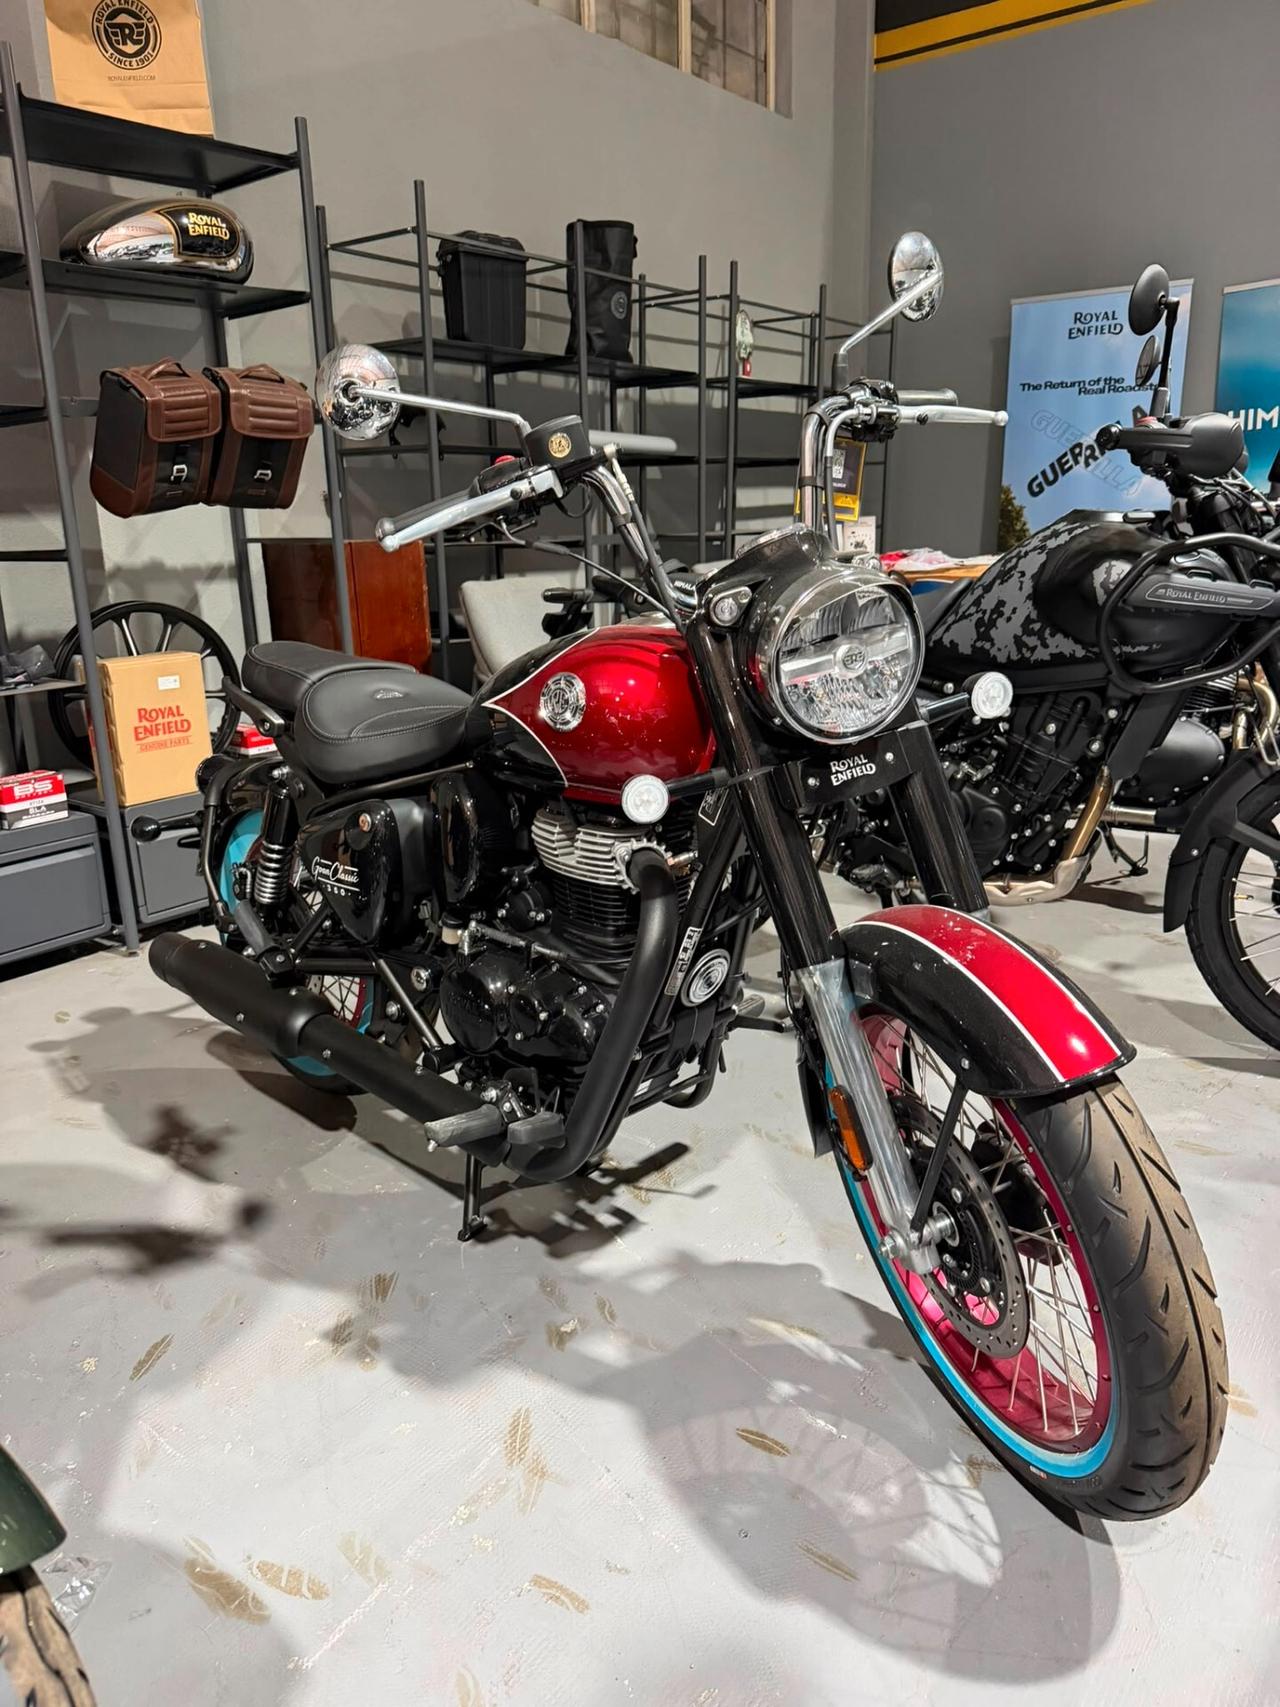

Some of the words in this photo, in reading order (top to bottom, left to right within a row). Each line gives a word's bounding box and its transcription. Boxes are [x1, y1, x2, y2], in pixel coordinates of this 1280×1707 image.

[95, 0, 117, 24] ROYAL
[117, 0, 154, 24] ENFIELD
[108, 52, 134, 67] SINCE
[135, 51, 154, 66] 1901
[188, 212, 226, 228] ROYAL
[188, 224, 230, 240] ENFIELD
[1074, 310, 1119, 325] ROYAL
[1068, 322, 1124, 339] ENFIELD
[1020, 383, 1042, 391] The
[1044, 379, 1087, 390] Return
[1088, 377, 1102, 387] of
[1103, 375, 1125, 386] the
[1078, 384, 1106, 396] Real
[1107, 382, 1159, 393] Roadst
[1166, 588, 1192, 599] ROYAL
[137, 705, 185, 723] ROYAL
[134, 719, 191, 741] ENFIELD
[830, 754, 868, 773] ROYAL
[831, 763, 876, 786] ENFIELD
[312, 856, 330, 880] Goan
[330, 861, 359, 883] Classic
